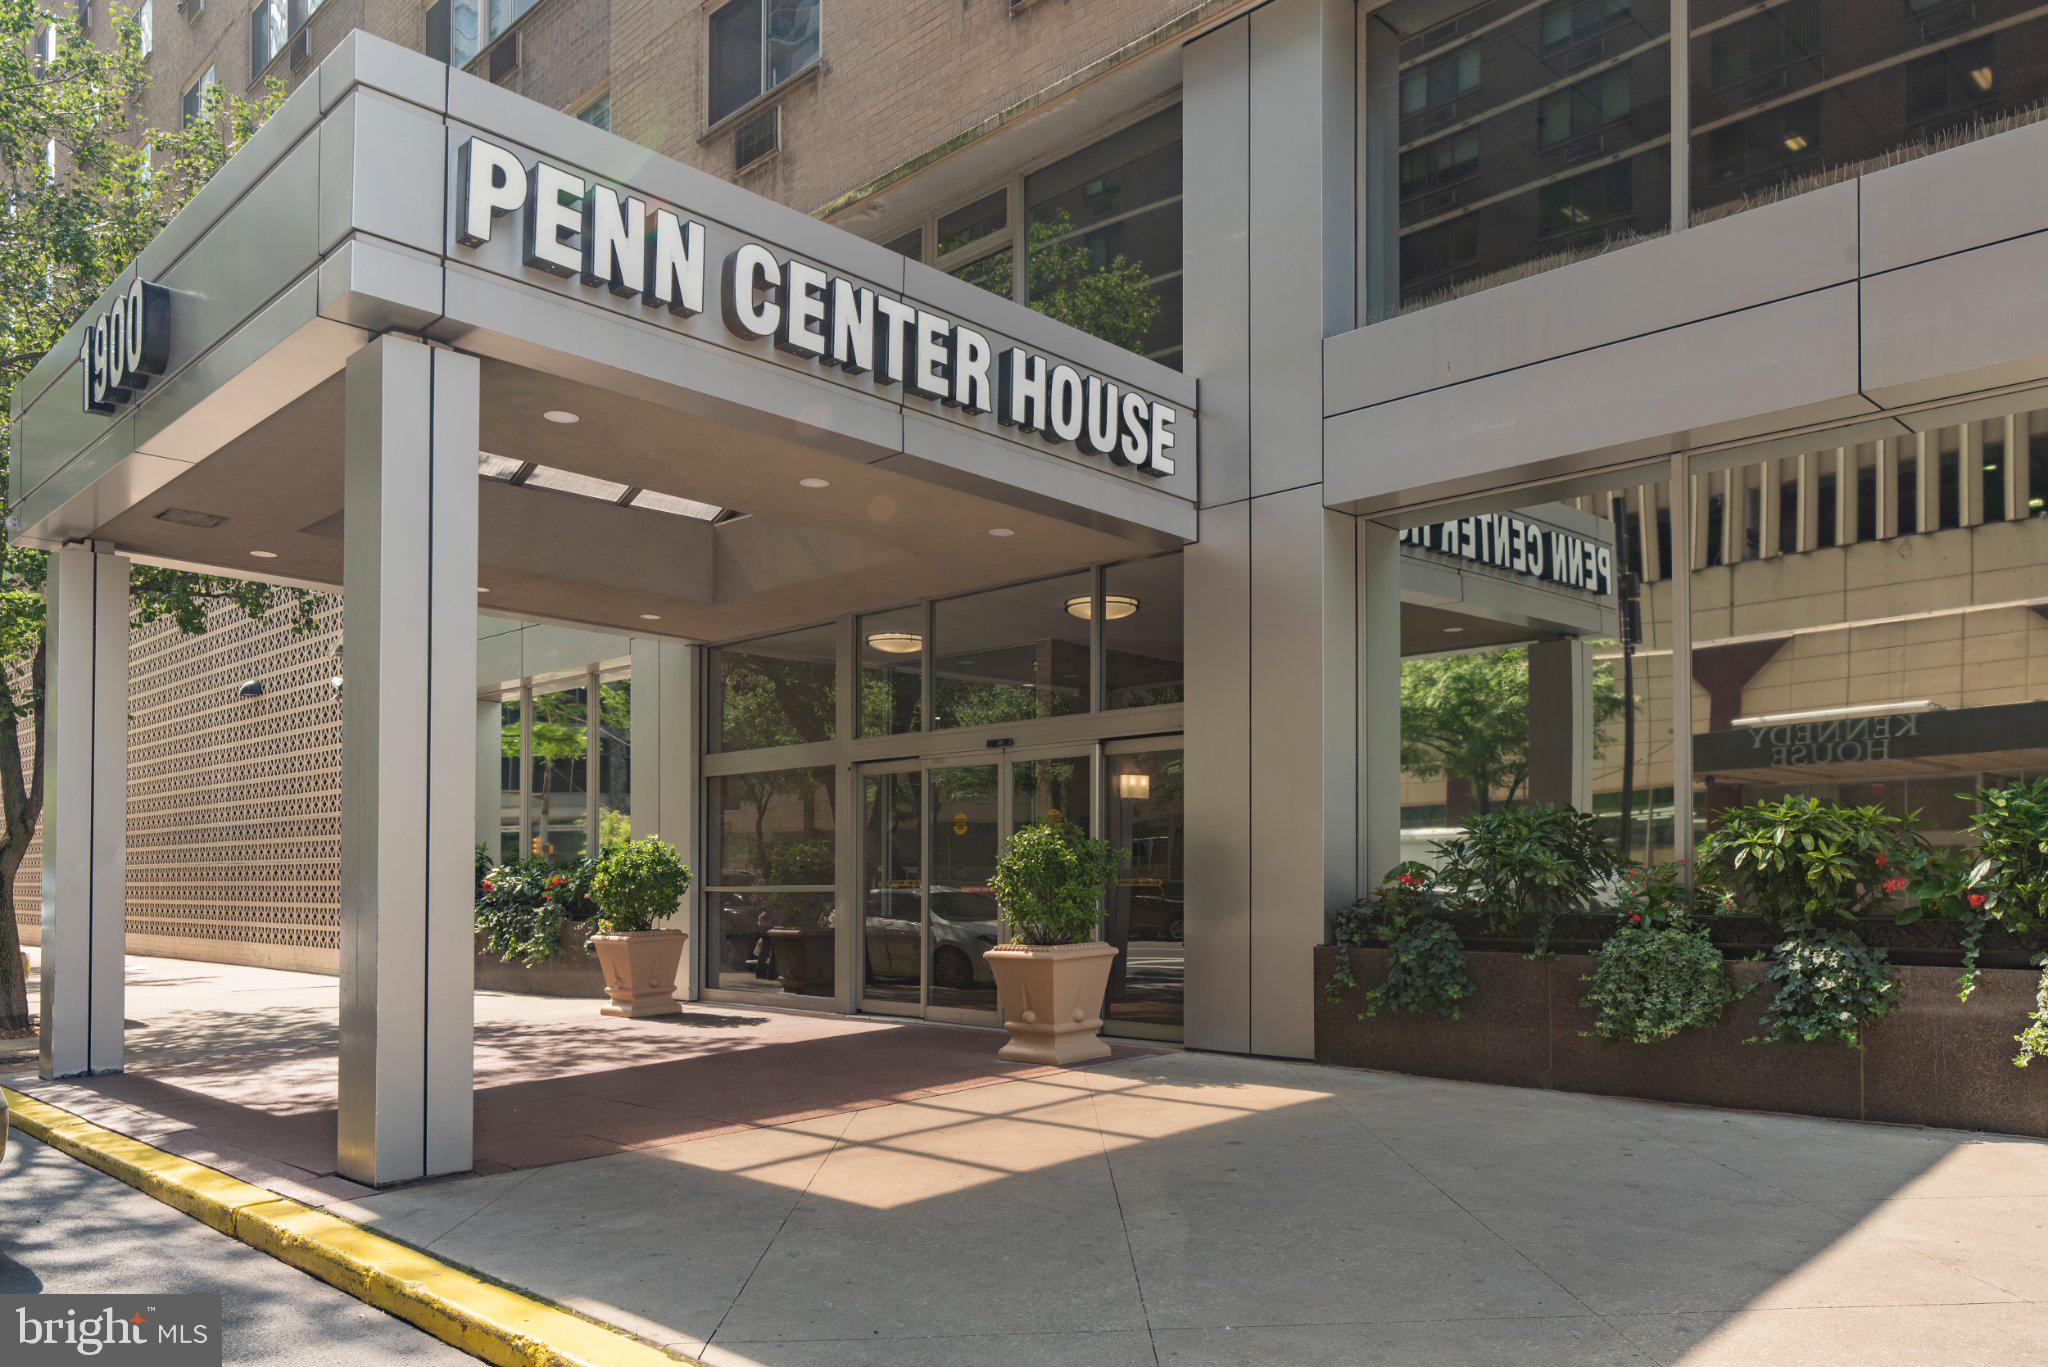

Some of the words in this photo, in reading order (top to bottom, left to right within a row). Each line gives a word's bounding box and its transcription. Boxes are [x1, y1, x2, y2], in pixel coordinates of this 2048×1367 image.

[79, 276, 147, 414] 1900
[463, 135, 706, 318] PENN
[724, 242, 993, 416] CENTER
[1003, 346, 1176, 477] HOUSE
